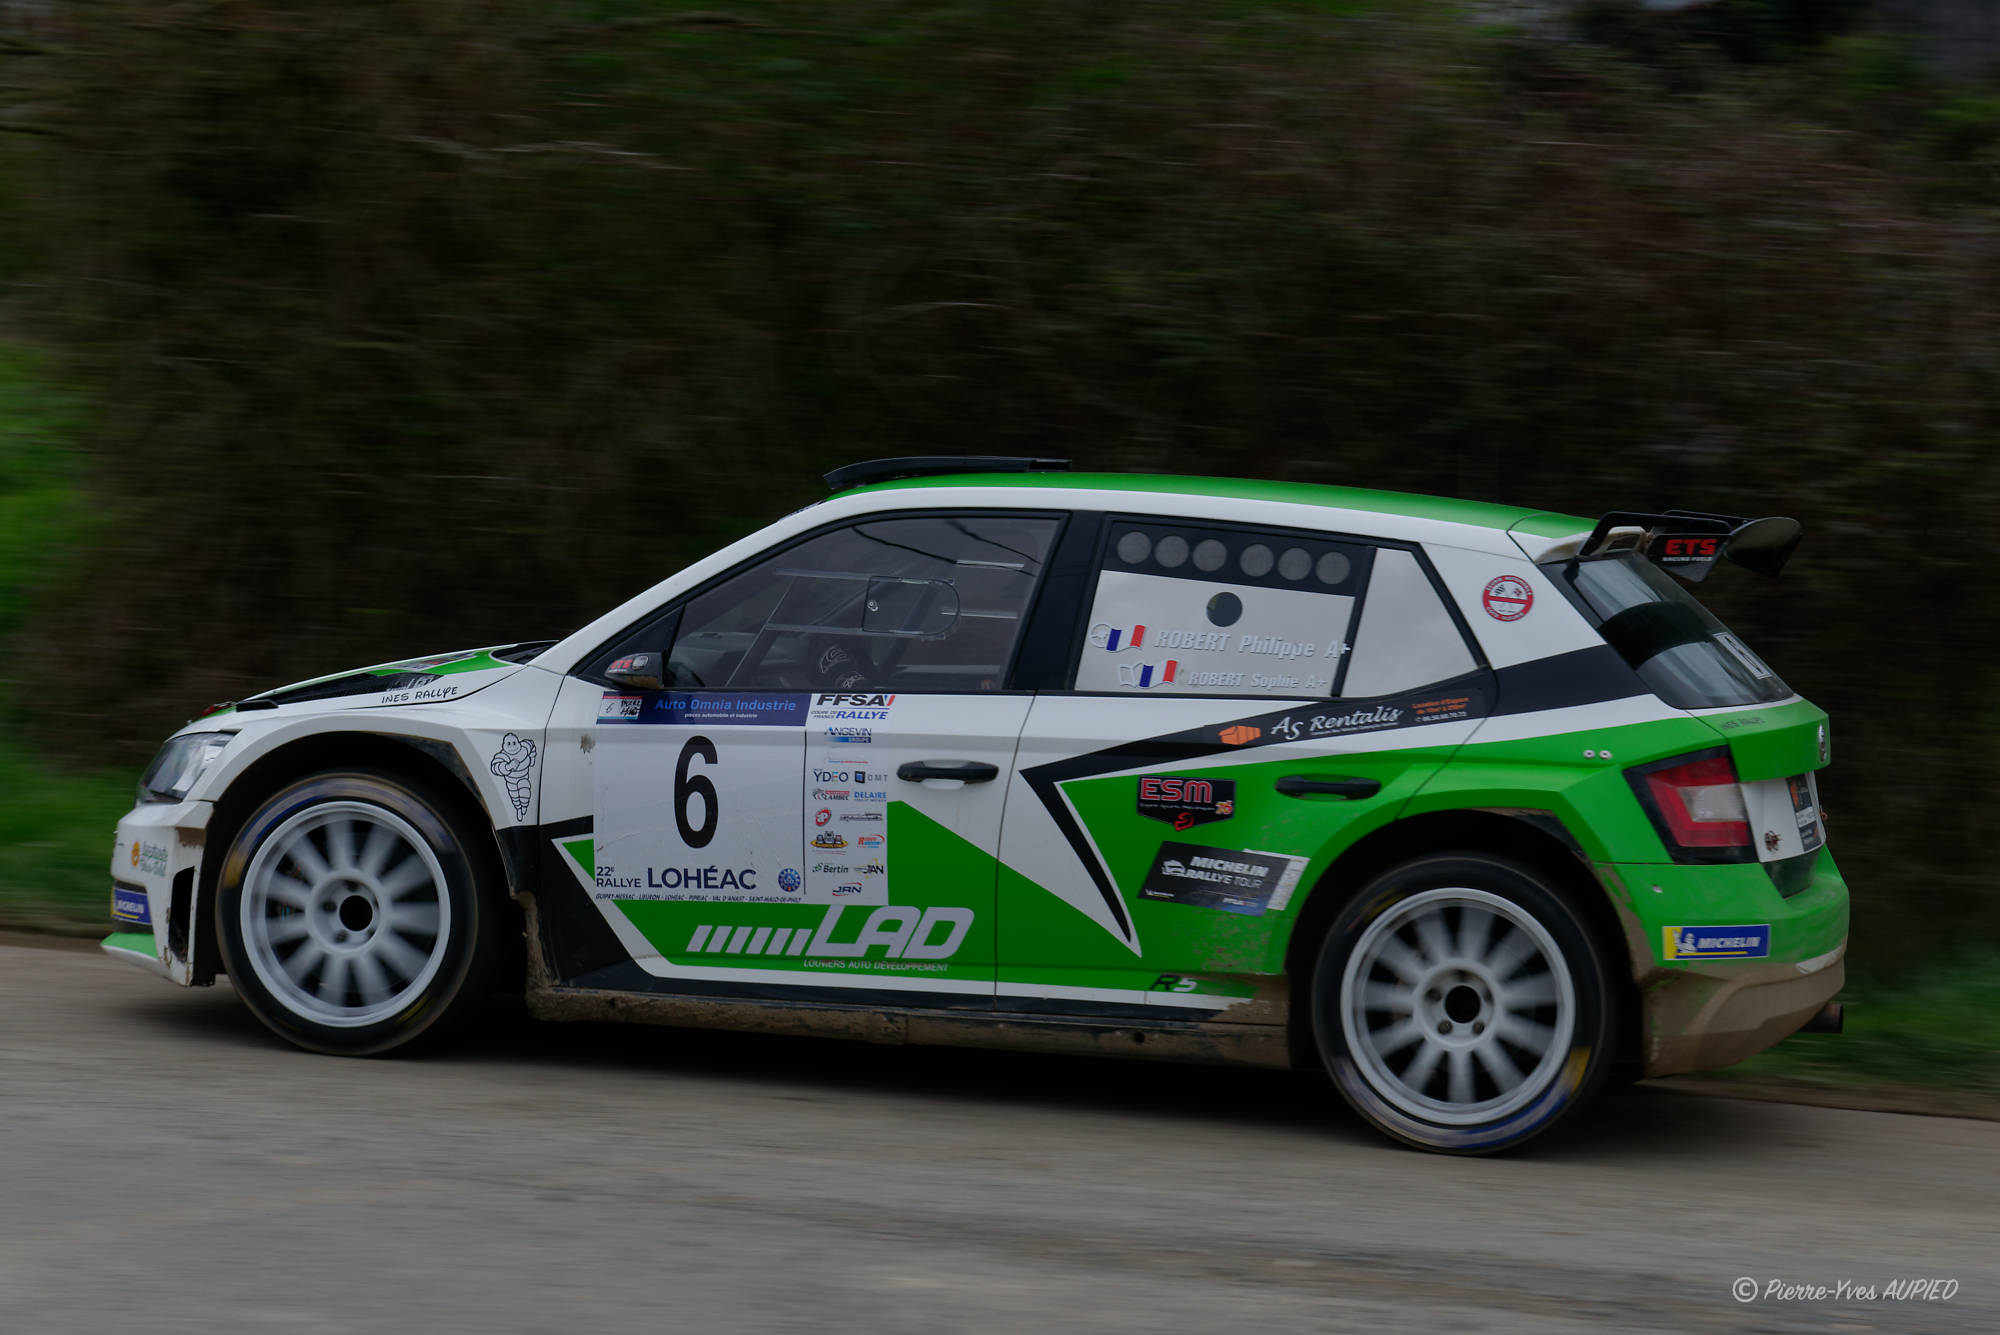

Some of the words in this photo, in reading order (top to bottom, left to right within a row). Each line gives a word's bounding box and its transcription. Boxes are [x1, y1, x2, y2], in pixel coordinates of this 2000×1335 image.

[1664, 538, 1718, 556] ETS
[1154, 630, 1231, 652] ROBERT
[1239, 634, 1316, 660] Philippe
[1324, 639, 1352, 659] A+
[1187, 671, 1247, 688] ROBERT
[1250, 673, 1300, 691] Sophie
[1305, 675, 1329, 689] A+
[381, 692, 410, 704] INES
[655, 699, 687, 710] Auto
[690, 698, 732, 711] Omnia
[736, 699, 797, 711] Industrie
[816, 694, 886, 707] FFSA
[836, 711, 889, 720] RALLYE
[1309, 705, 1405, 732] Rentalis
[824, 727, 872, 737] ANGEVIN
[813, 771, 849, 783] YDEO
[674, 735, 719, 849] 6
[854, 791, 888, 799] DELAIRE
[1140, 778, 1213, 803] ESM
[823, 865, 849, 873] Bertin
[863, 865, 885, 875] JAN
[1189, 856, 1270, 878] MICHELIN
[596, 878, 641, 888] RALLYE
[647, 865, 757, 890] LOHÉAC
[1185, 869, 1233, 884] RALLYE
[1233, 875, 1265, 889] TOUR
[805, 904, 975, 960] LAD
[1696, 936, 1761, 950] MICHELIN
[803, 958, 846, 969] LOUVIERS
[848, 960, 872, 970] AUTO
[1149, 974, 1198, 993] R5
